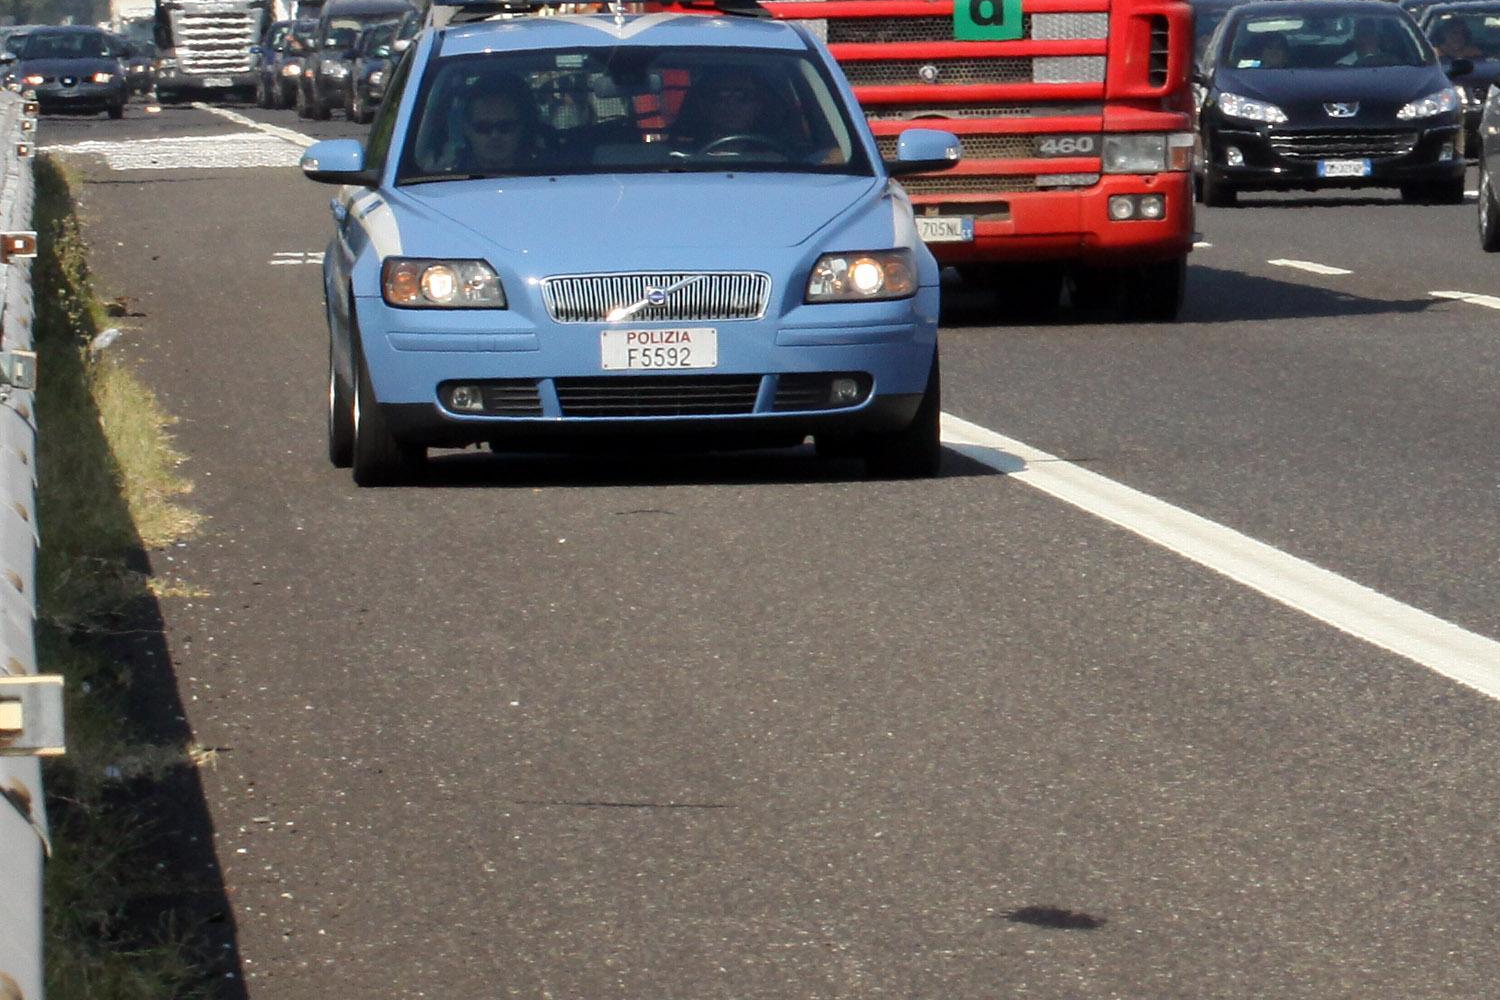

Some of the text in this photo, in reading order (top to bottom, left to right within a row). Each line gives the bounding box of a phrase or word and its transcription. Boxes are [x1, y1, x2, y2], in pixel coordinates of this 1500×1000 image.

[1039, 137, 1094, 154] 460
[626, 331, 692, 345] POLIZIA
[627, 347, 692, 368] F5592
